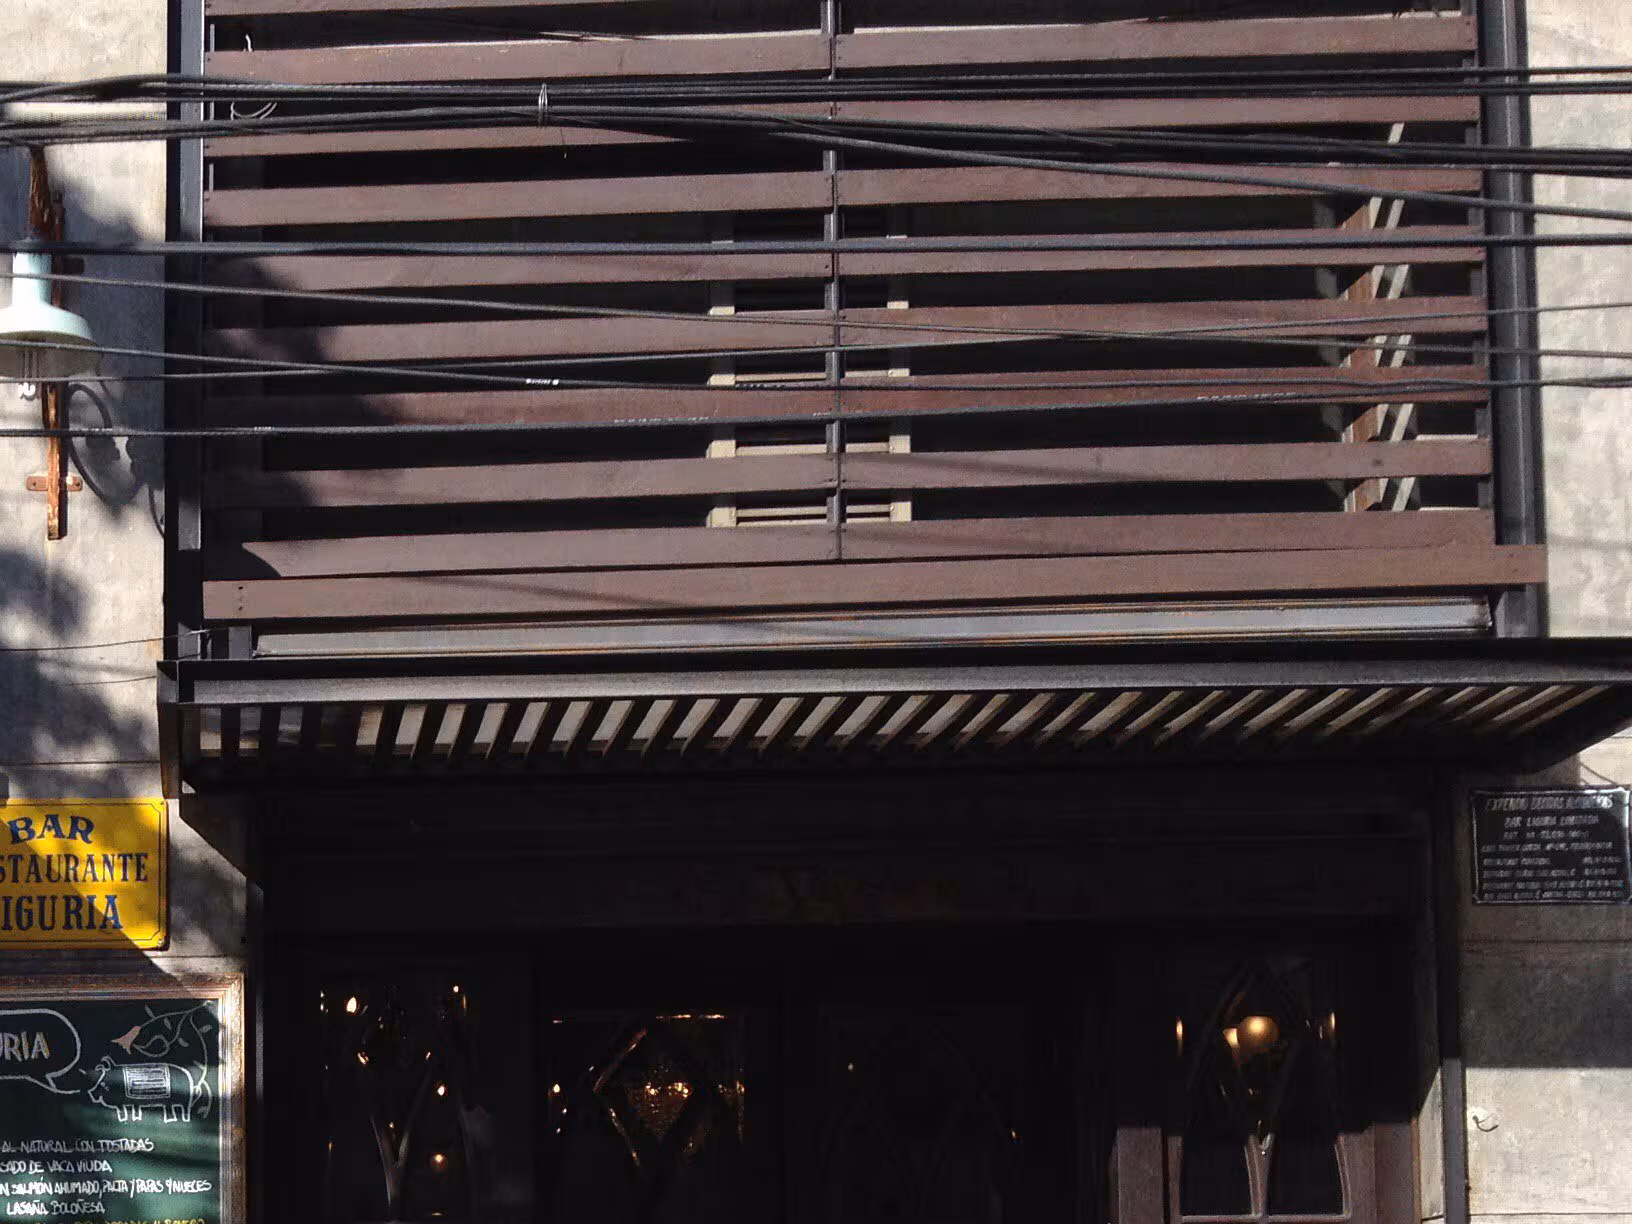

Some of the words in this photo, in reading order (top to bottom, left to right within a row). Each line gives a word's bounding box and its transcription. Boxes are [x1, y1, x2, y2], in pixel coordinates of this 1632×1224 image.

[8, 814, 95, 845] BAR
[2, 1140, 16, 1153] AL
[20, 1140, 68, 1153] NATURAL
[75, 1138, 95, 1153] CON
[97, 1138, 155, 1152] TOSTADAS
[29, 1160, 45, 1174] DE
[48, 1160, 75, 1173] VACA
[6, 1200, 49, 1215] LASAÑA
[51, 1199, 105, 1215] BOLOÑESA
